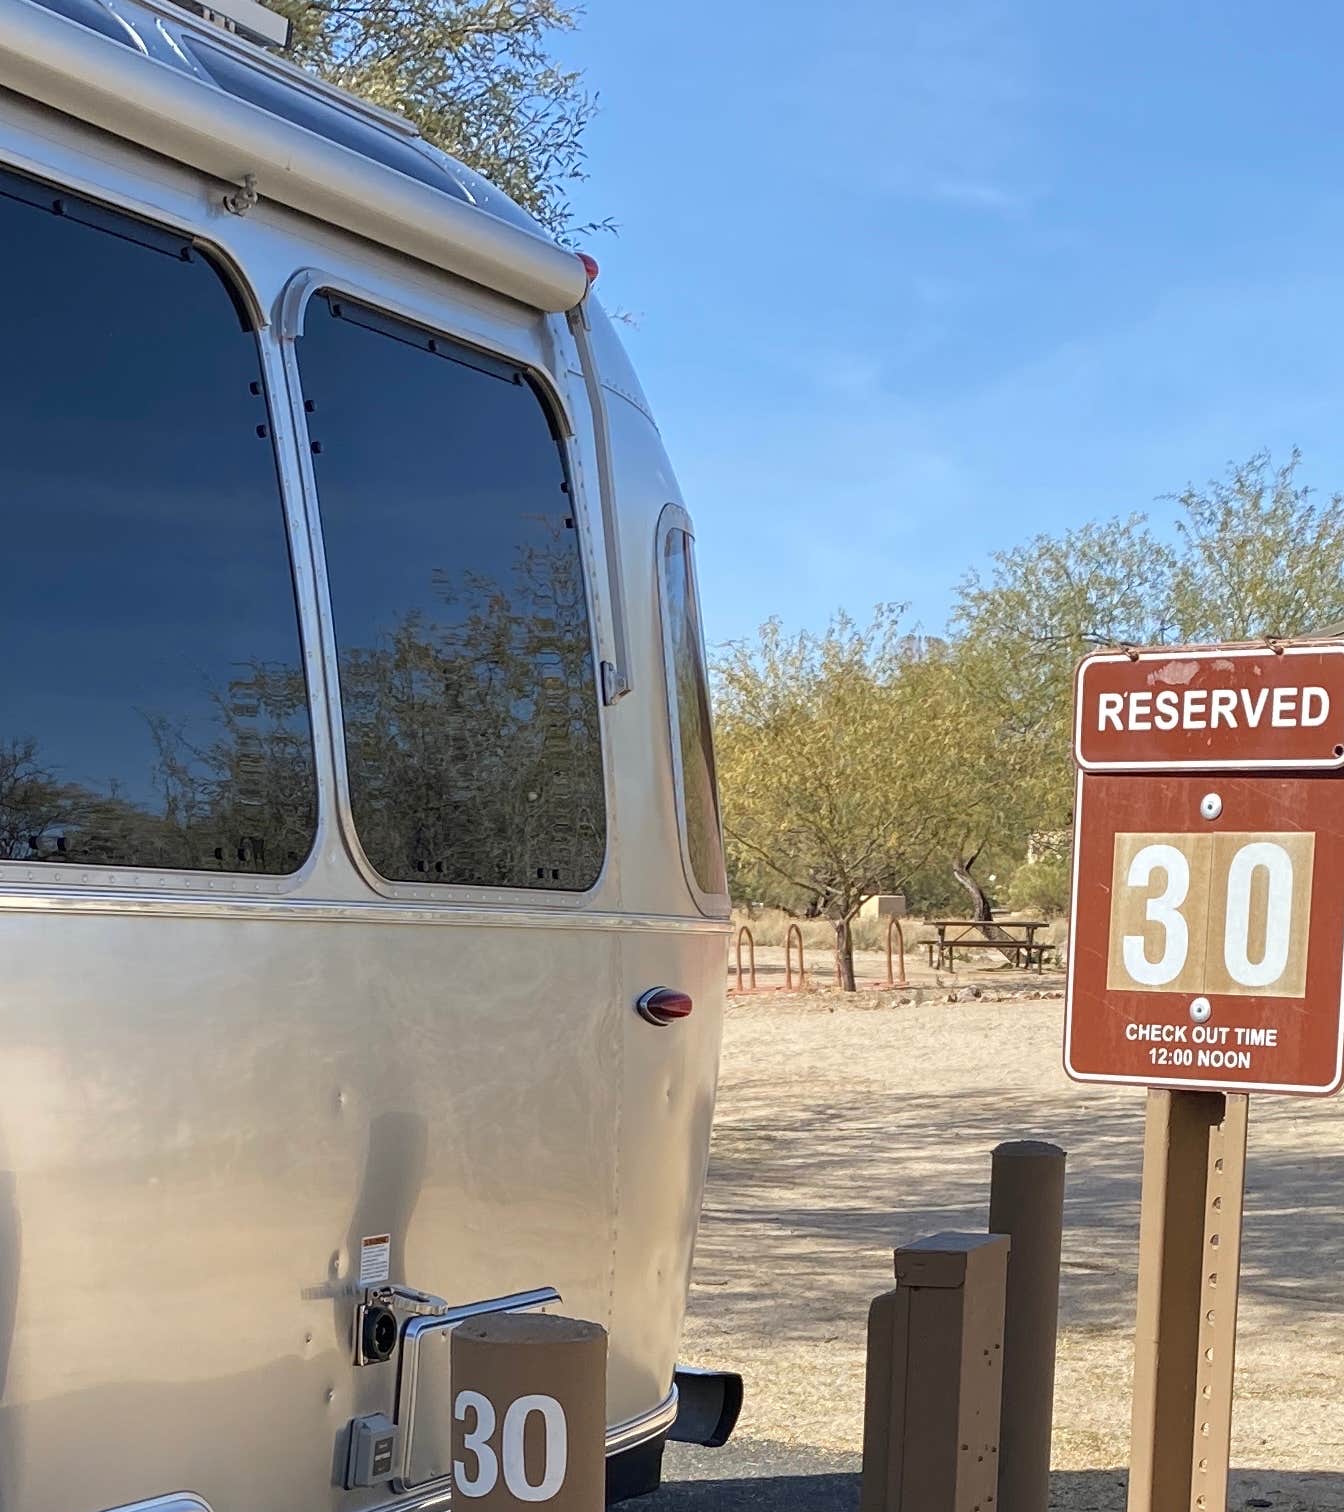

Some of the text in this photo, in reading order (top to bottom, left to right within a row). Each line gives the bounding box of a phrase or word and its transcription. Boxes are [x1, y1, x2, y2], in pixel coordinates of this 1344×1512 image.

[1097, 686, 1331, 732] RESERVED
[1122, 842, 1294, 988] 30
[1125, 1023, 1278, 1047] CHECK OUT TIME
[1148, 1047, 1251, 1069] 12:00 NOON
[453, 1390, 568, 1502] 30
